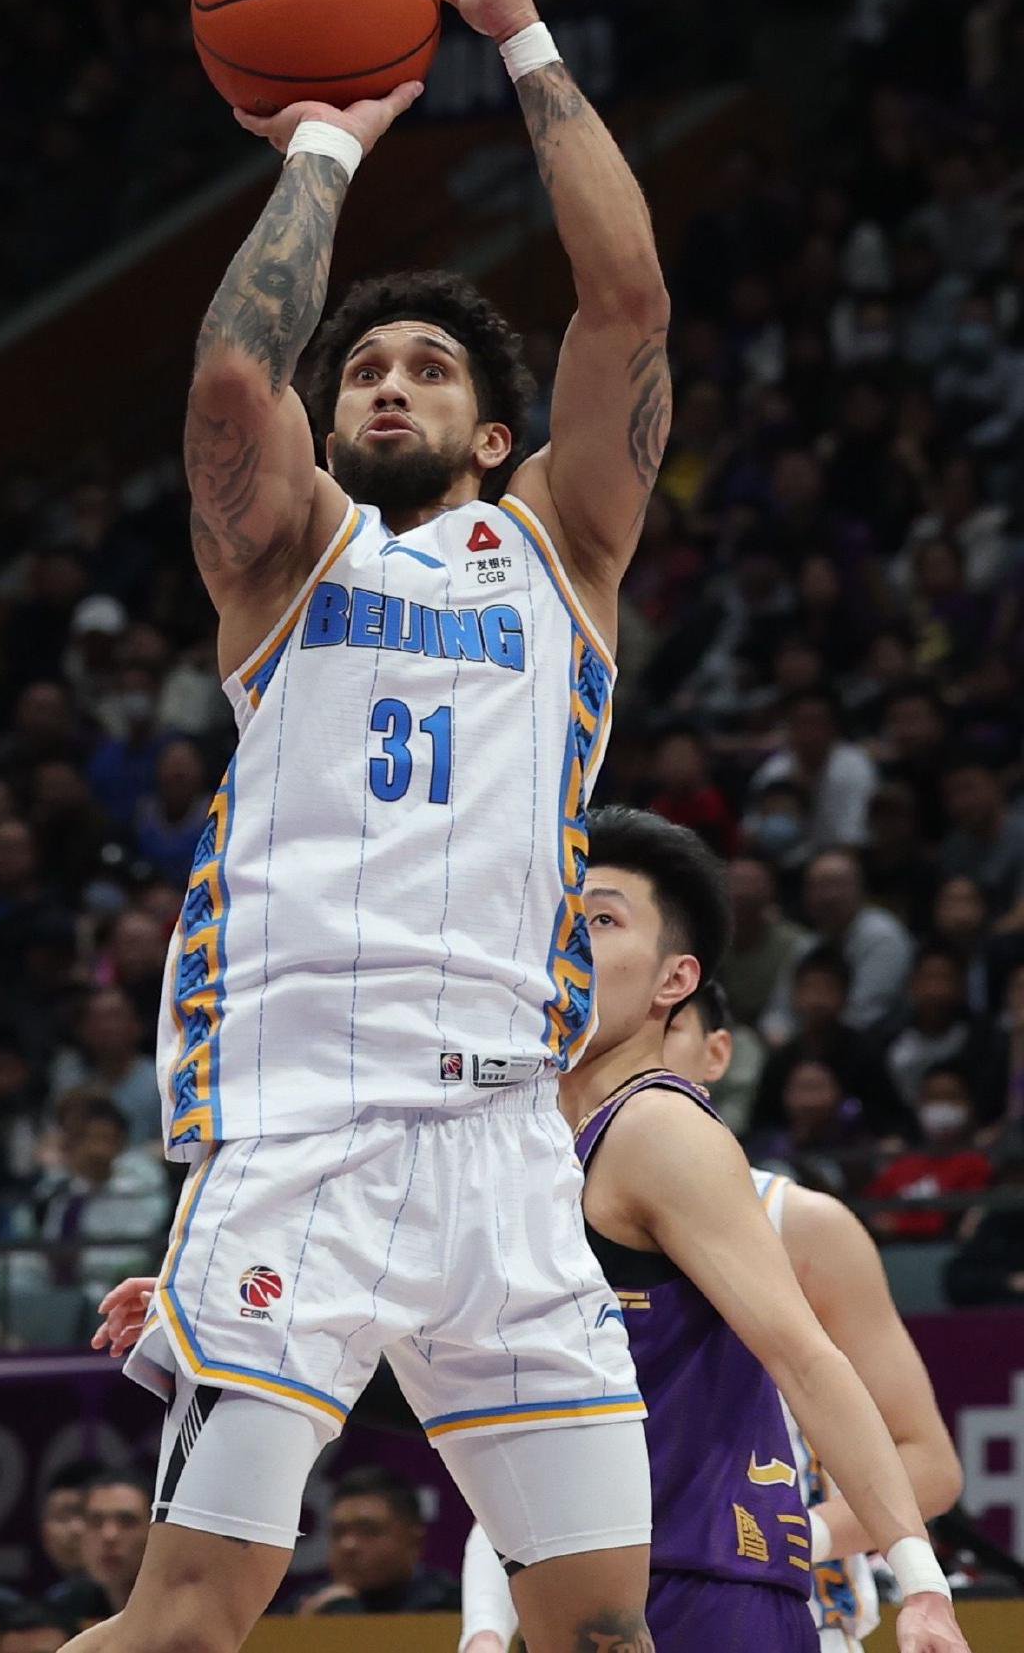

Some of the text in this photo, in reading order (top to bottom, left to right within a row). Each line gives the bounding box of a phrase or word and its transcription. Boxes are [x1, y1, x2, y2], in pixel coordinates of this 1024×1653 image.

[465, 556, 512, 572] 广发银行
[477, 571, 506, 584] CGB
[301, 581, 525, 672] BEIJING
[369, 698, 451, 804] 31
[240, 1307, 274, 1322] CBA
